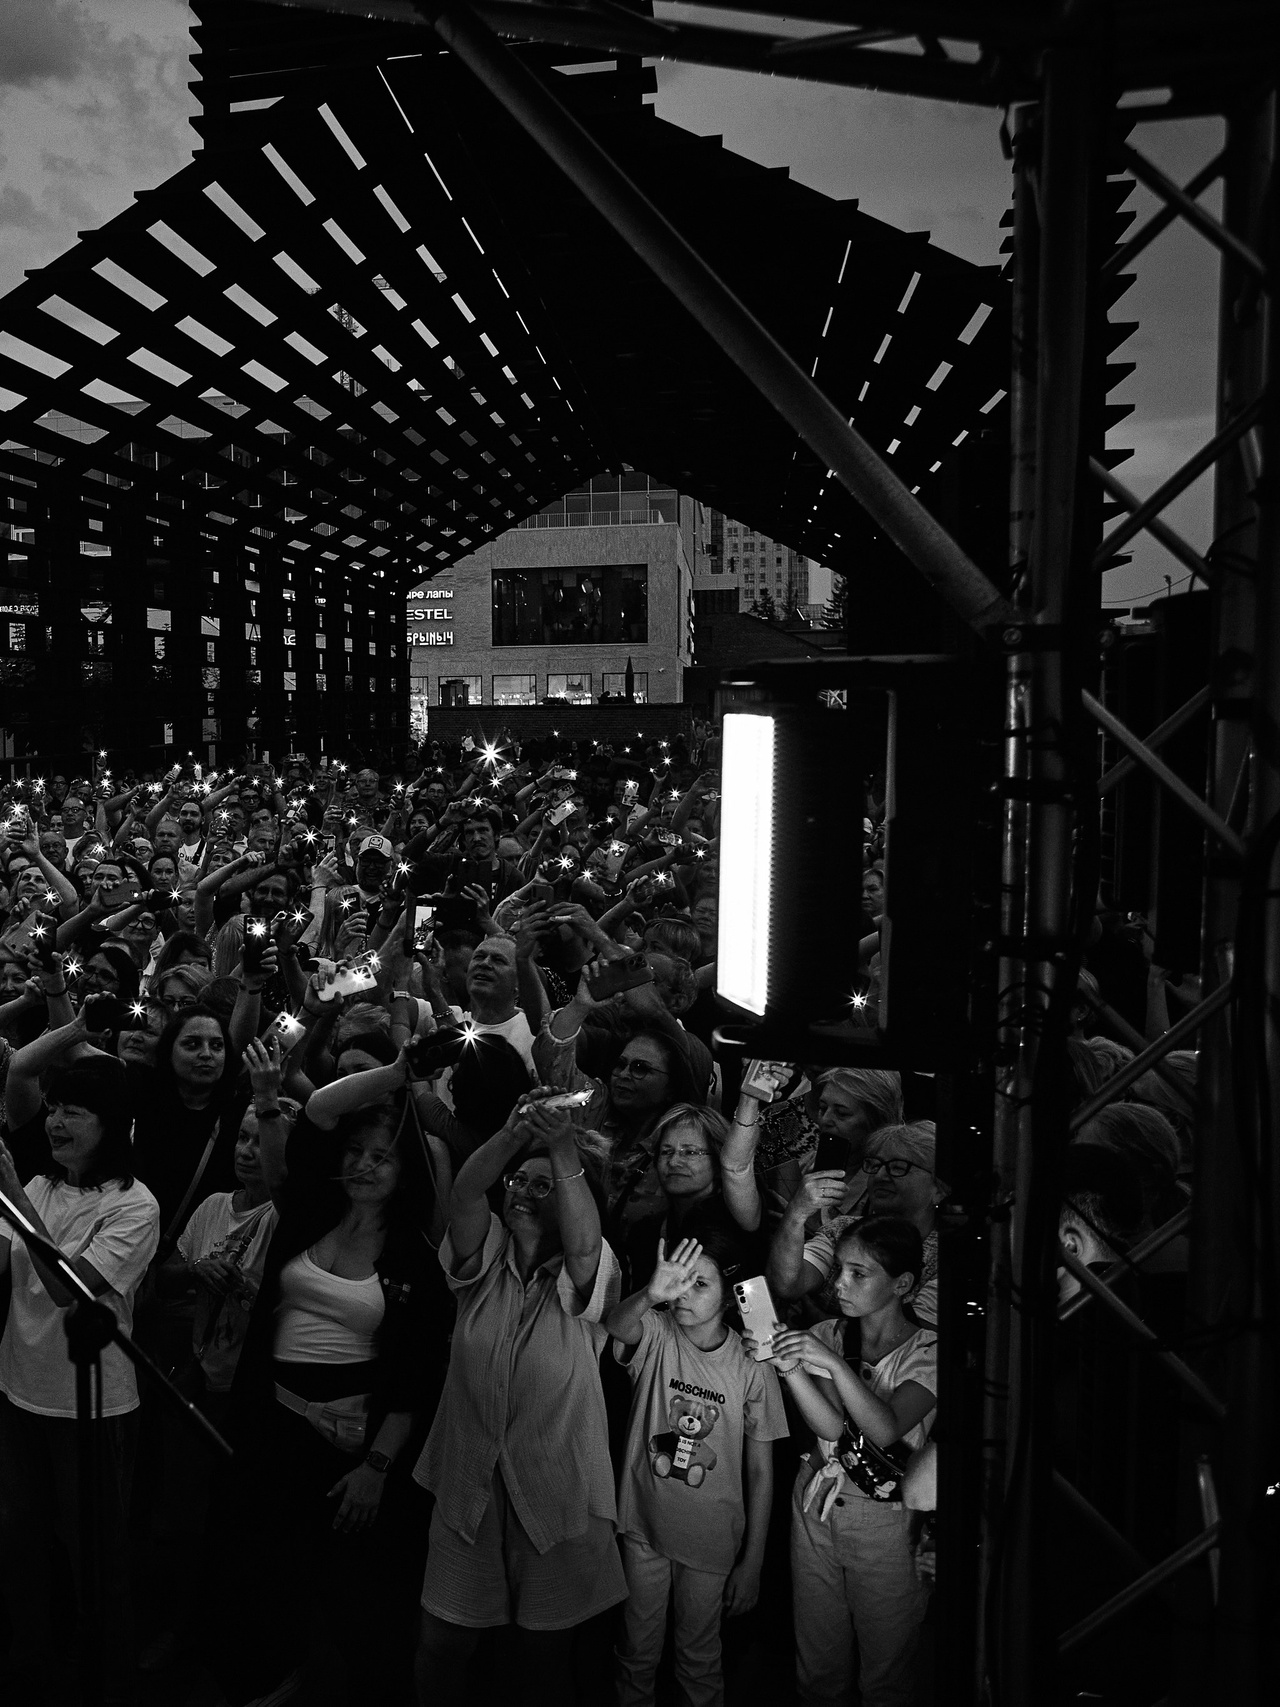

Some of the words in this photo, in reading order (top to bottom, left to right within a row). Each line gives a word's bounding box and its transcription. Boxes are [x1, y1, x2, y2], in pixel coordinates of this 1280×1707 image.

[426, 590, 453, 599] лапы
[406, 608, 453, 620] ESTEL
[669, 1378, 726, 1405] MOSCHINO
